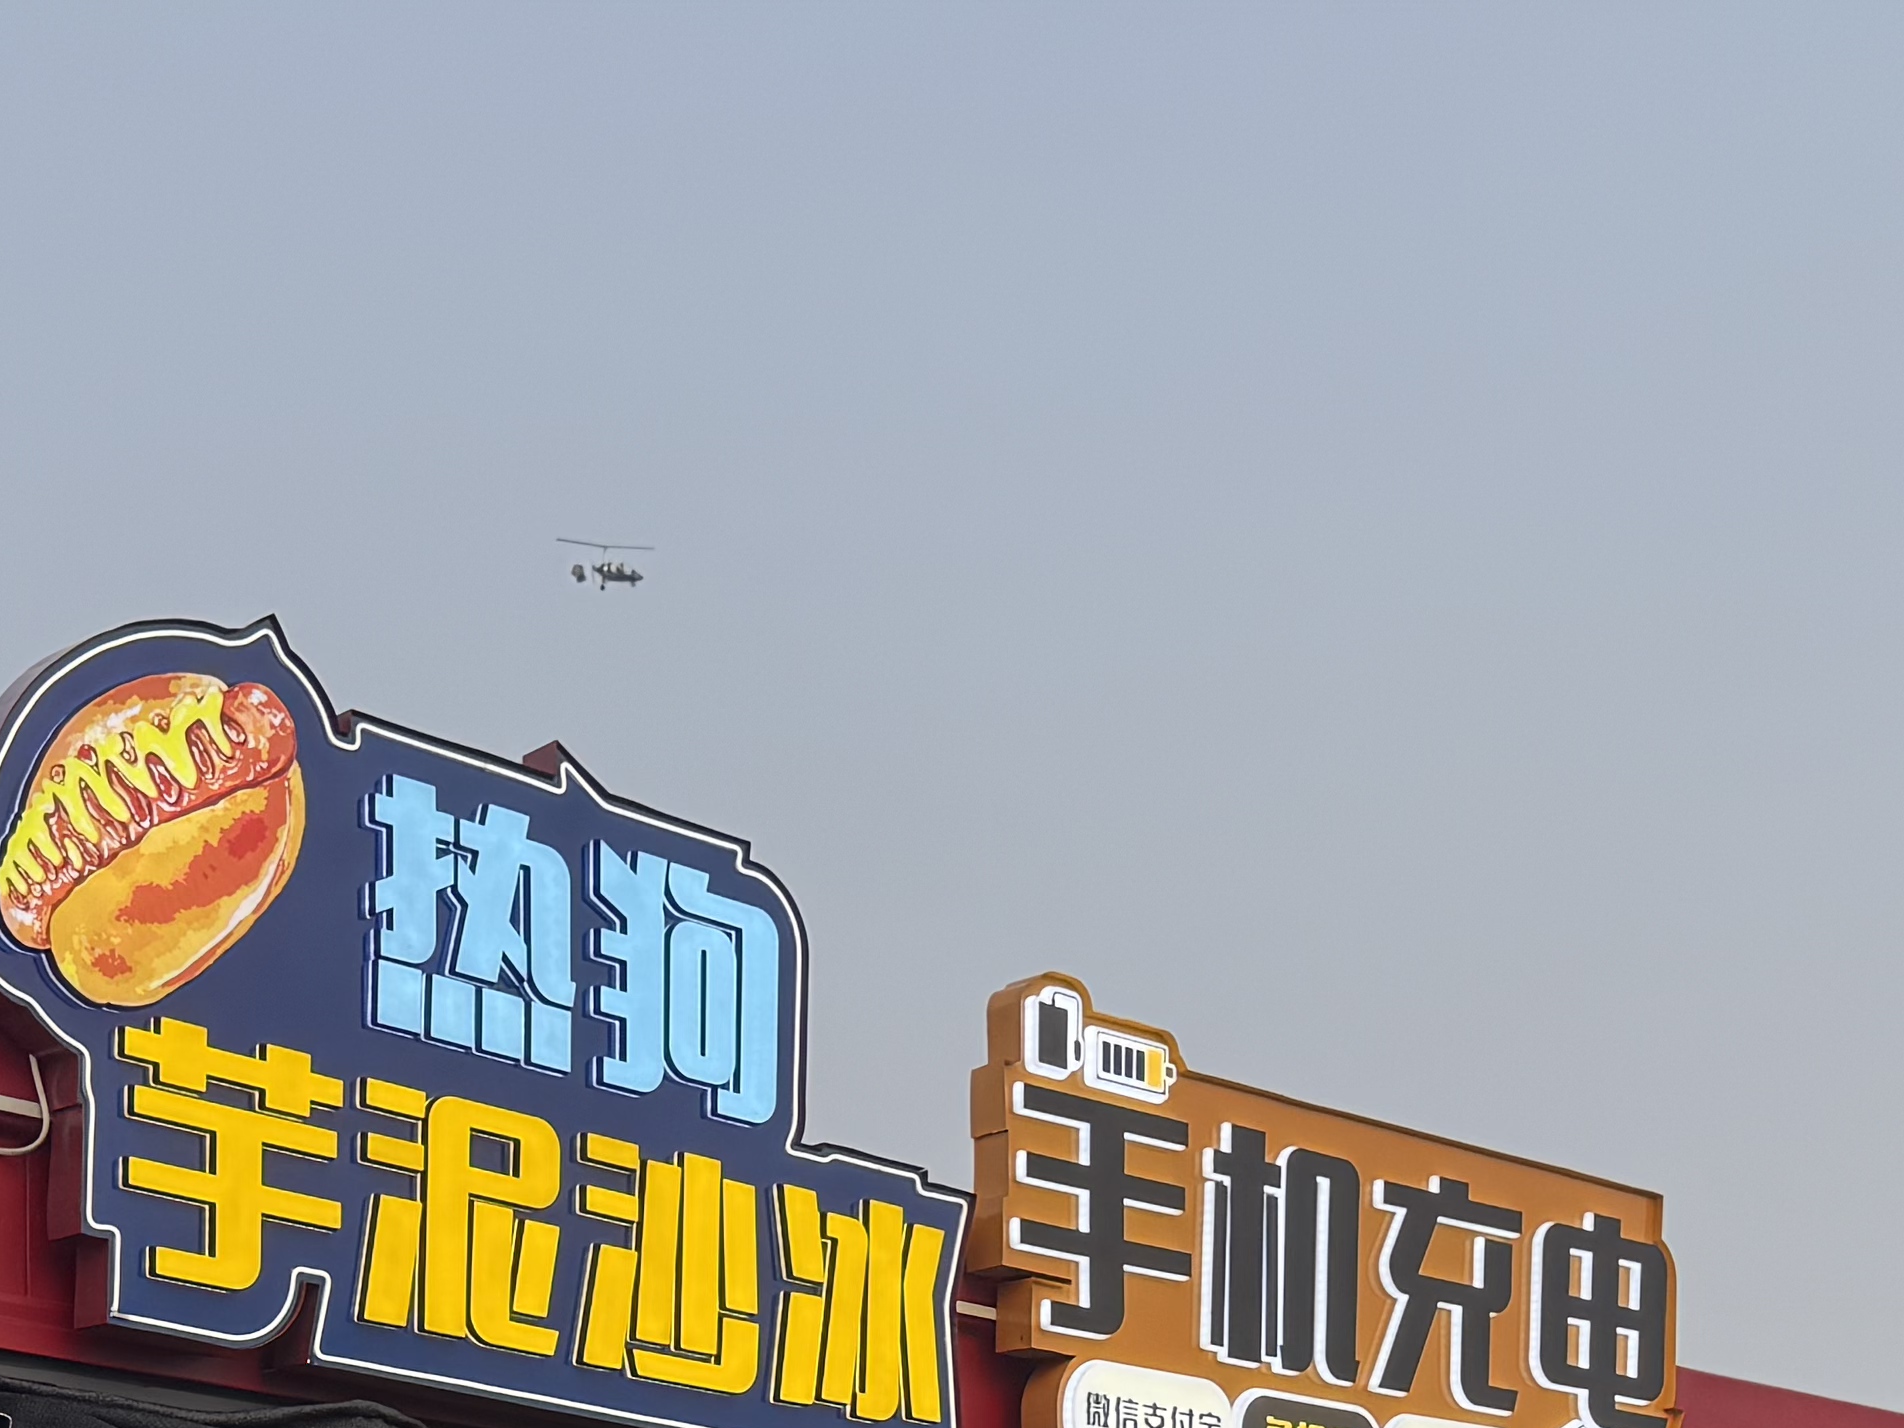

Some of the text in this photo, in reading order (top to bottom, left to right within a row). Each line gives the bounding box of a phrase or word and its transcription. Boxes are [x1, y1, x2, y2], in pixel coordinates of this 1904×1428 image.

[362, 774, 780, 1125] 热狗
[114, 1016, 945, 1425] 芋泥沙冰
